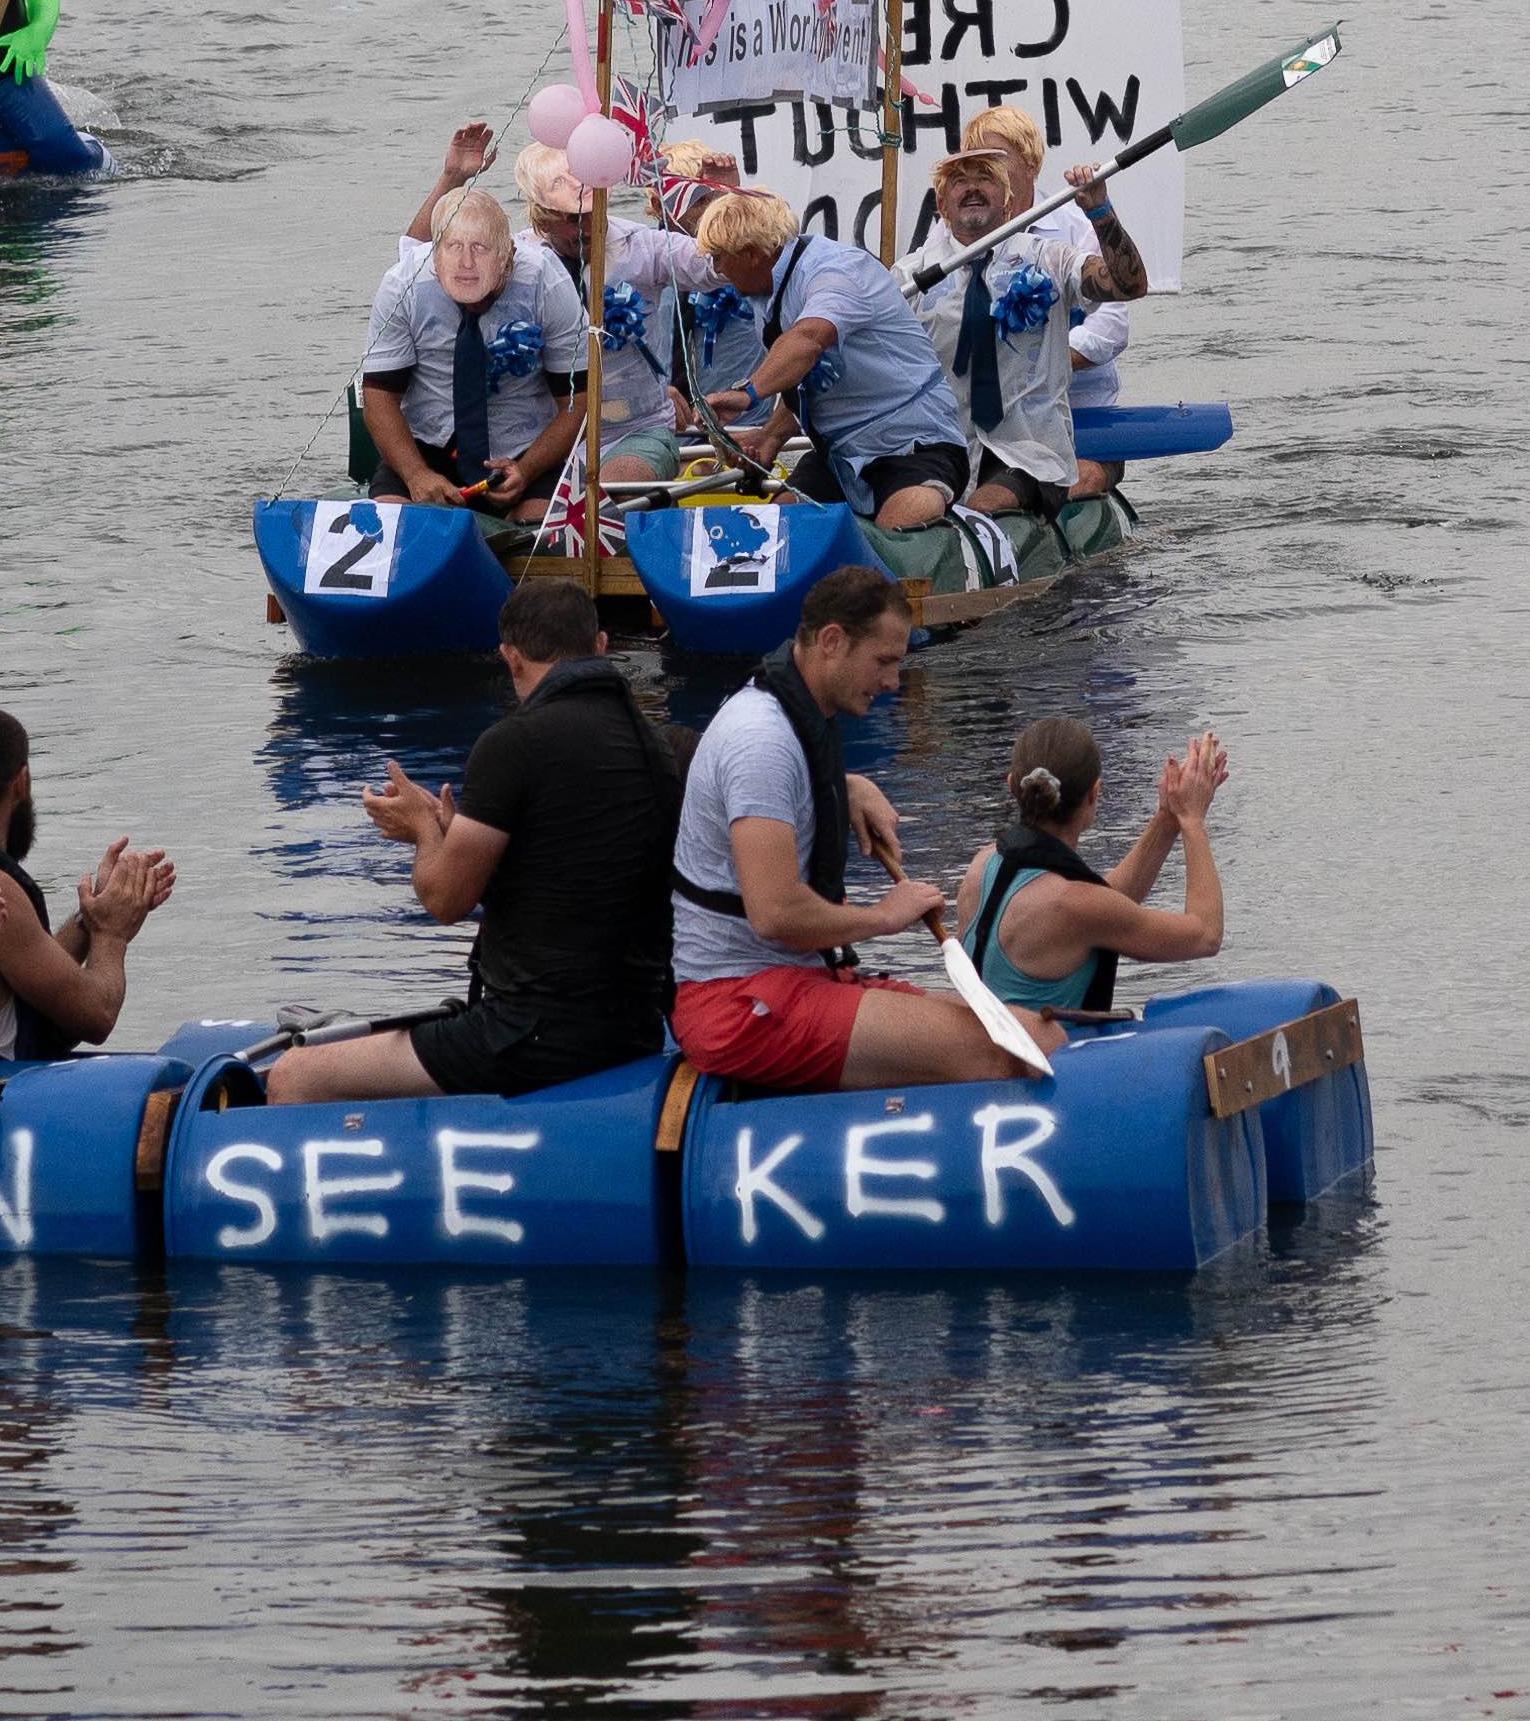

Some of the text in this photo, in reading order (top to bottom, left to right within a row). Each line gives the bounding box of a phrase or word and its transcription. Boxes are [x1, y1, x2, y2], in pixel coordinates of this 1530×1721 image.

[729, 12, 747, 62] is
[753, 18, 763, 58] a
[769, 0, 820, 56] Work
[825, 10, 871, 65] vent!
[319, 510, 384, 591] 2
[206, 1129, 540, 1248] SEE
[735, 1103, 1076, 1242] KER
